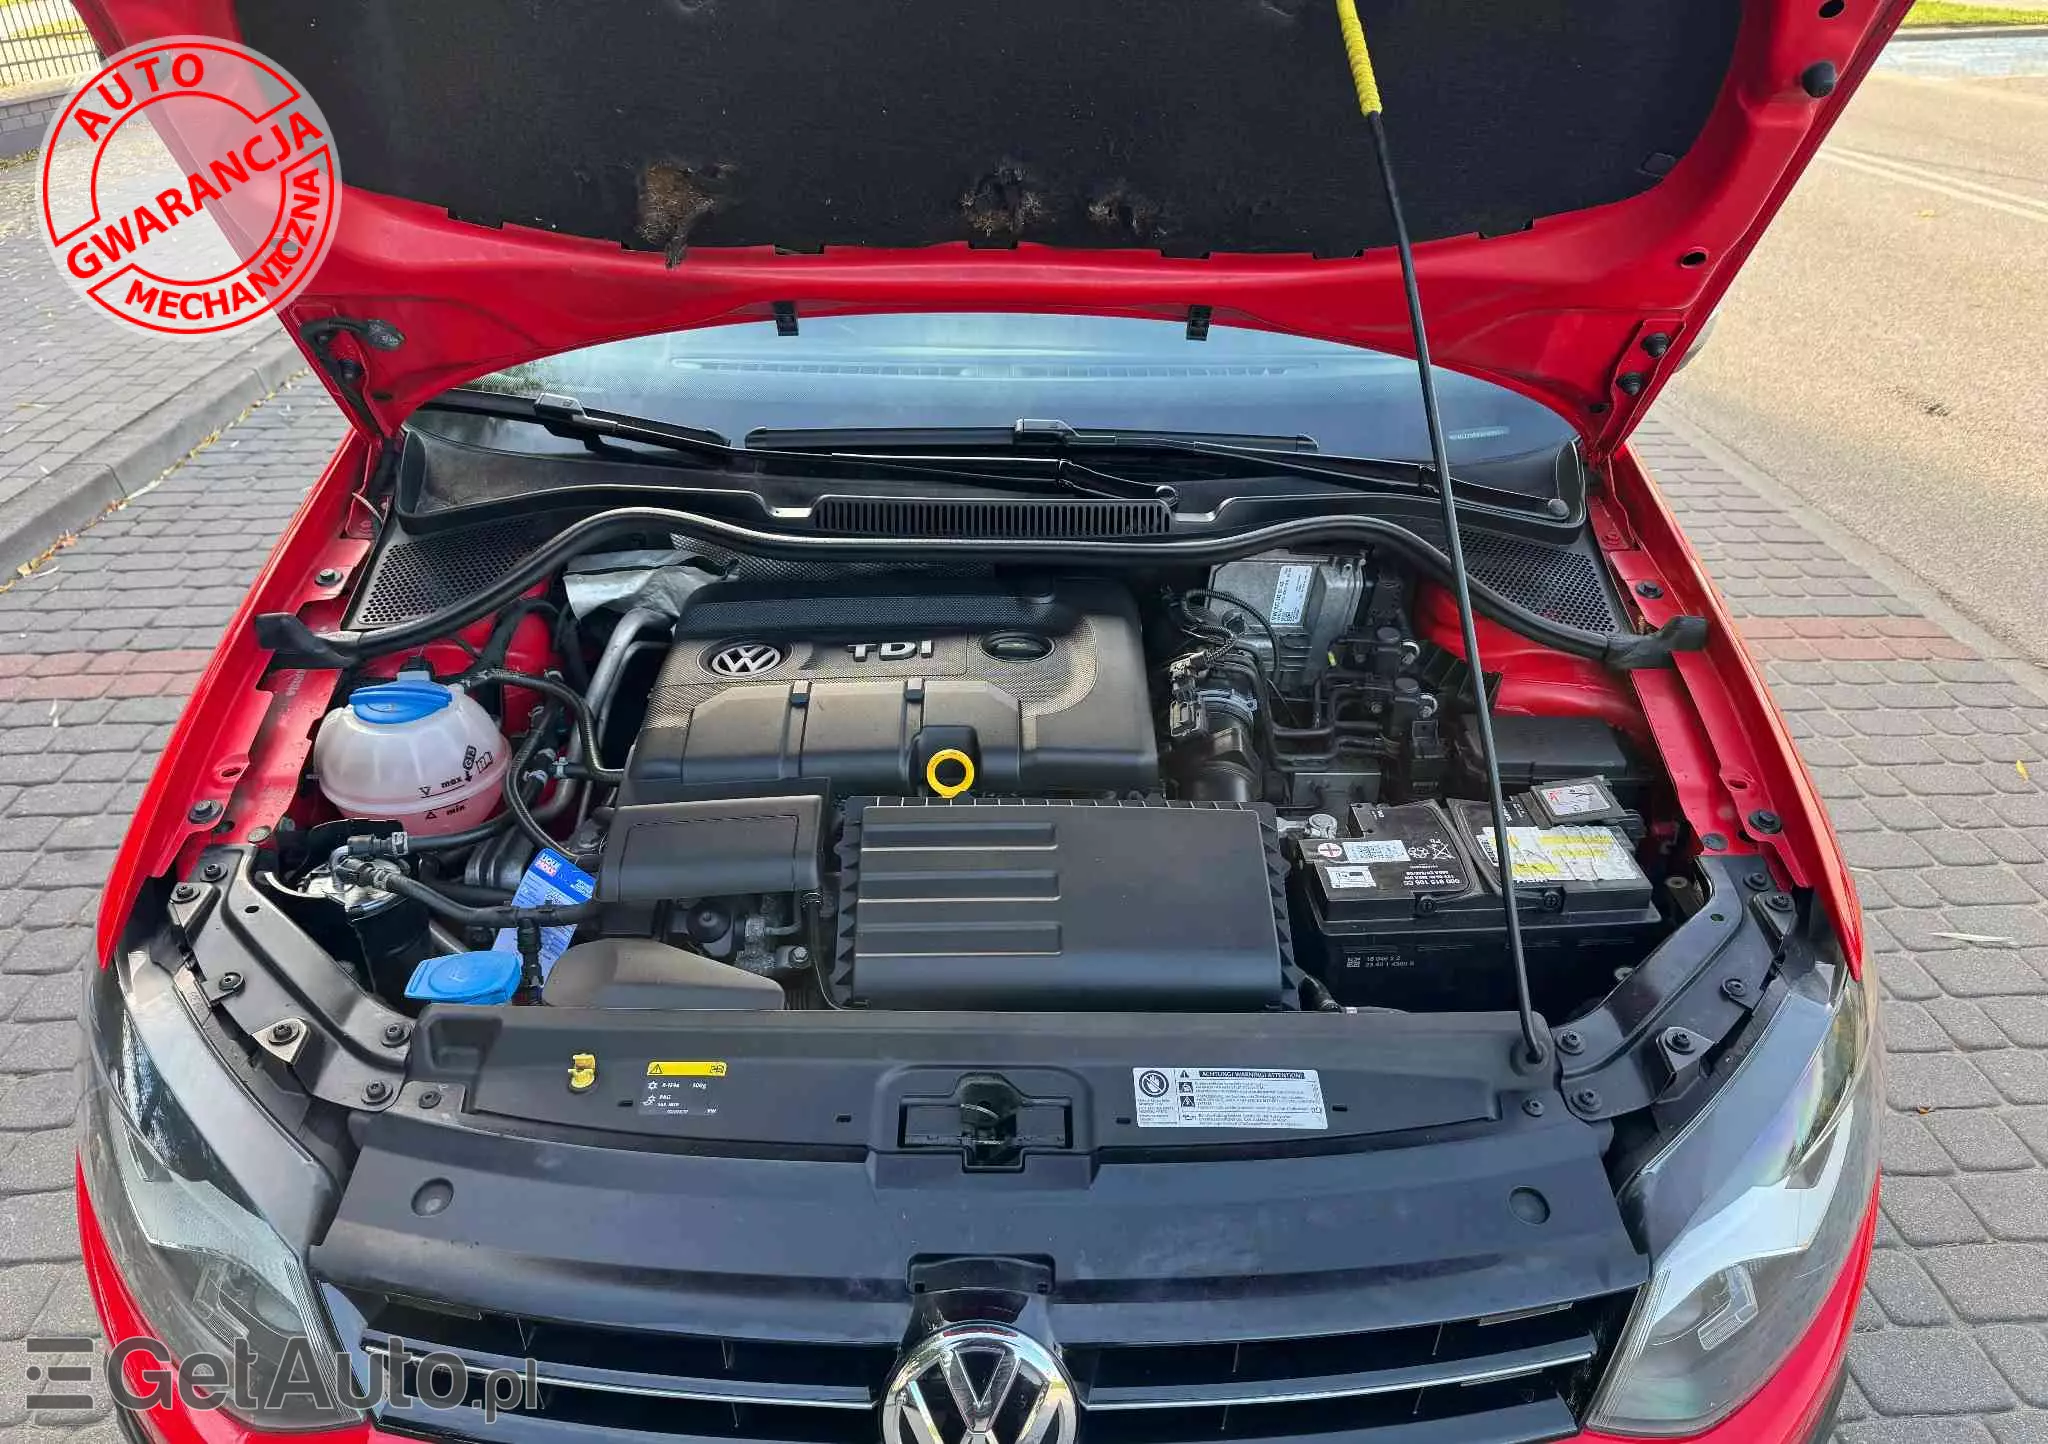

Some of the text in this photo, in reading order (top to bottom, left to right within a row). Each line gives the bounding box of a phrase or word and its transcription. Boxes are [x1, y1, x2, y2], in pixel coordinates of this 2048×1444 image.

[847, 640, 934, 662] TDI
[441, 776, 463, 788] max
[446, 805, 466, 815] min
